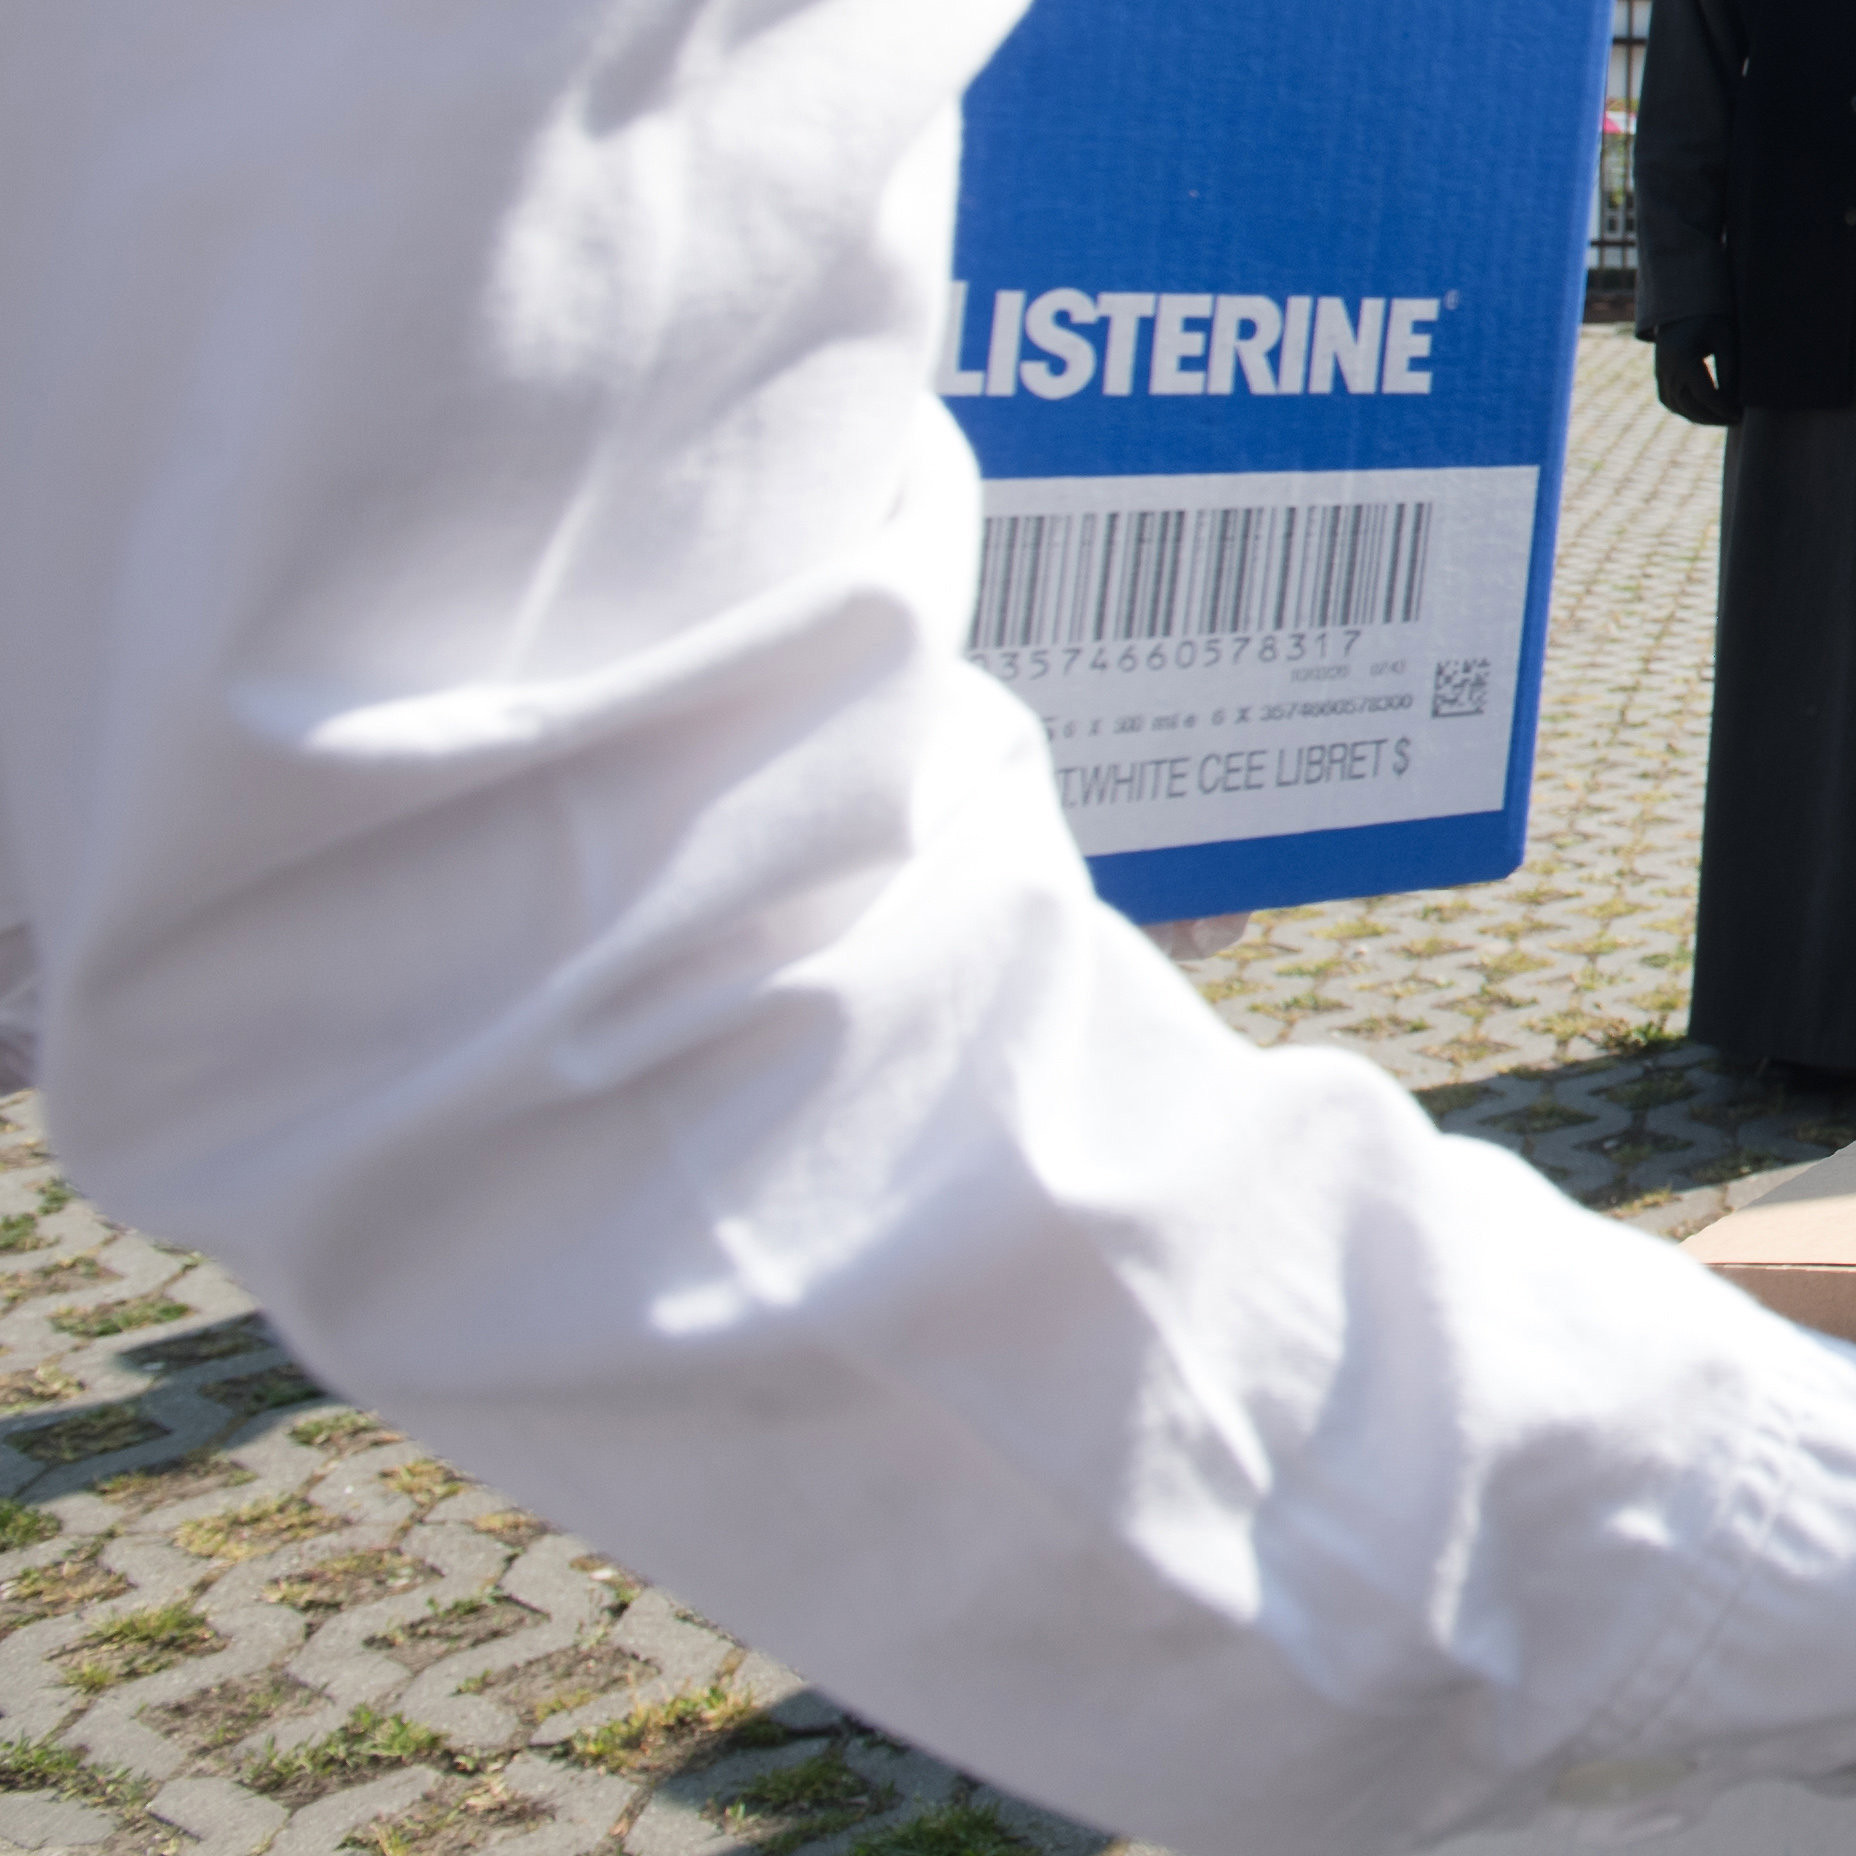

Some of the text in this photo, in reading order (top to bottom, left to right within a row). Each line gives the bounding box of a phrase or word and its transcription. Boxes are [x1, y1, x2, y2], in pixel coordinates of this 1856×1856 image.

[935, 281, 1440, 400] LISTERINE
[1058, 756, 1190, 809] T.WHITE
[1198, 749, 1268, 796] CEE
[1275, 737, 1389, 788] LIBRET
